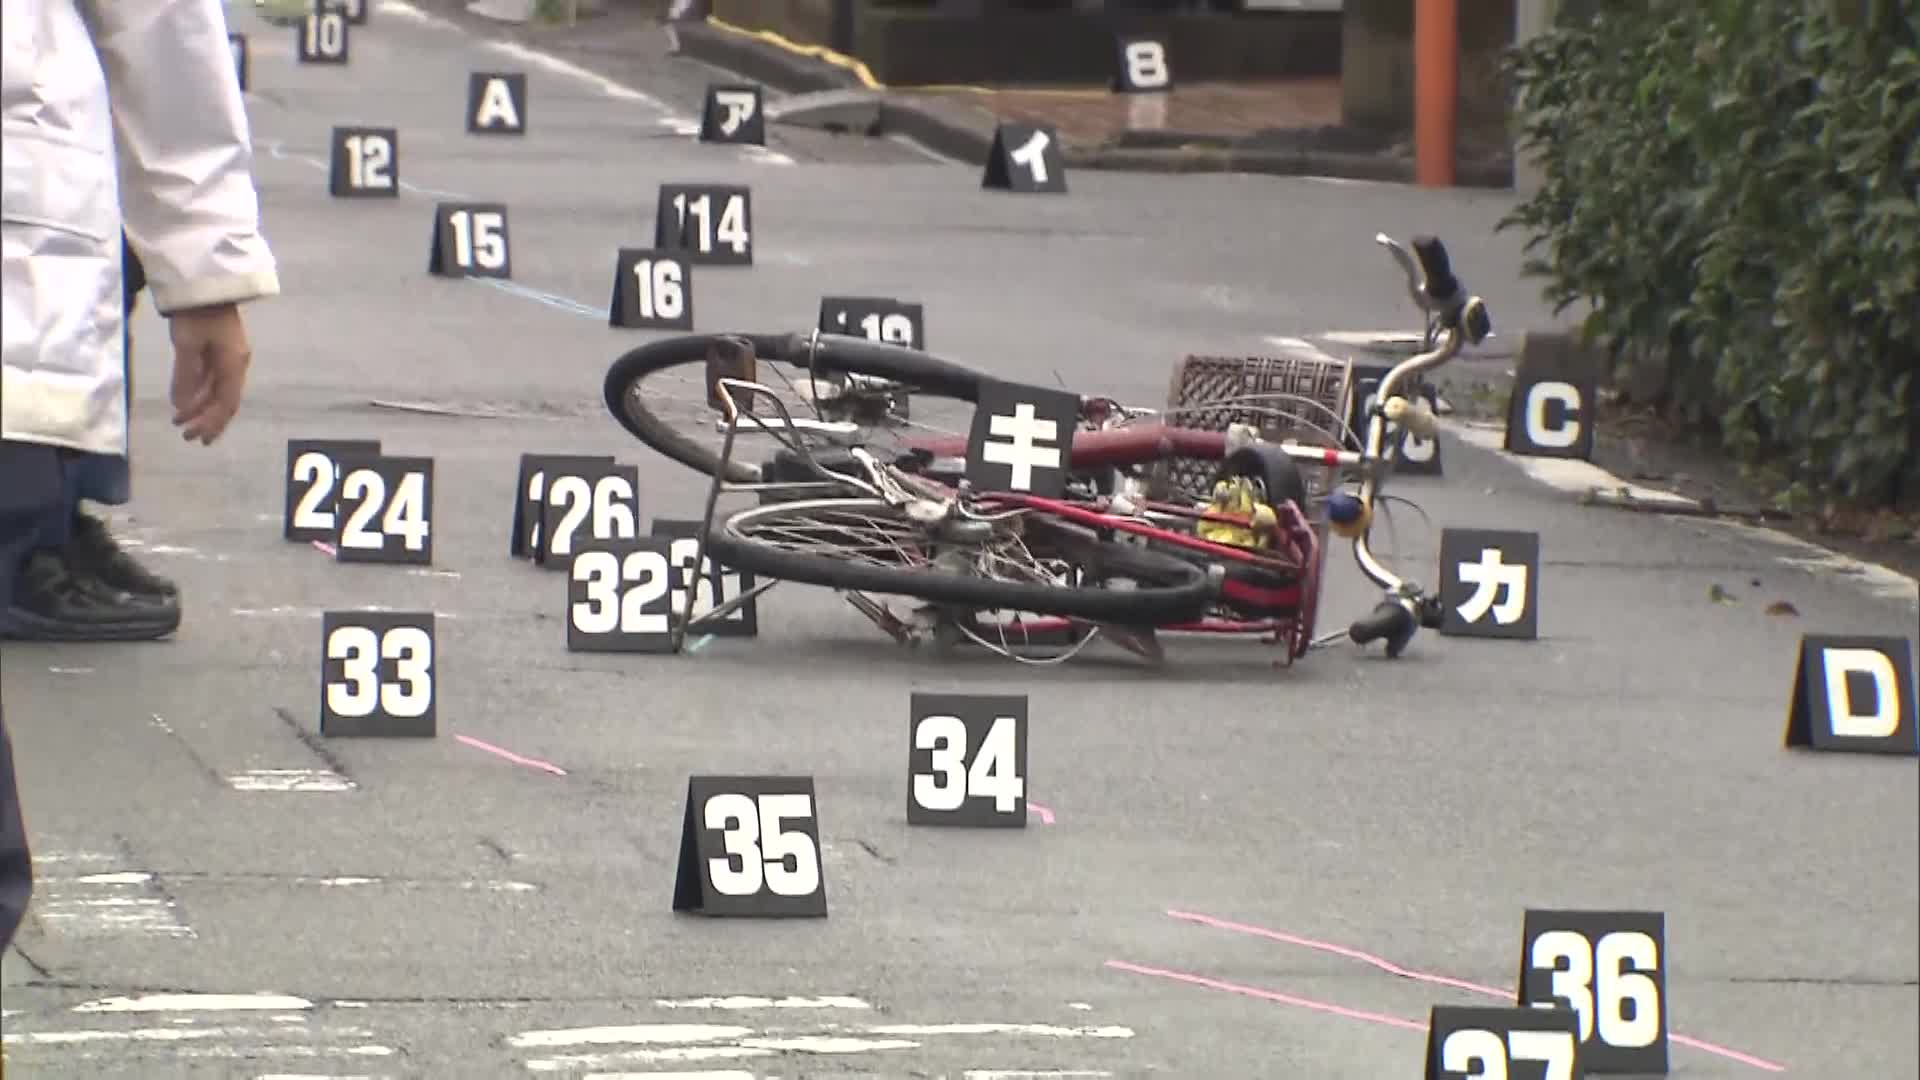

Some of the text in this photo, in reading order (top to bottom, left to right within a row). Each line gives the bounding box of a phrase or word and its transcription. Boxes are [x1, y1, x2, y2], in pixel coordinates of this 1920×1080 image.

[477, 78, 519, 127] A
[716, 92, 756, 135] ア
[345, 135, 392, 188] 12
[1010, 130, 1050, 183] イ
[449, 210, 505, 269] 15
[688, 194, 749, 254] 14
[633, 259, 684, 320] 16
[982, 403, 1061, 491] キ
[1525, 381, 1580, 447] C
[293, 451, 340, 529] 2
[340, 468, 430, 551] 24
[549, 475, 636, 556] 26
[572, 550, 669, 635] 32
[1456, 548, 1527, 625] カ
[326, 626, 433, 718] 33
[1823, 648, 1901, 738] D
[913, 715, 1024, 813] 34
[704, 793, 820, 896] 35
[1530, 929, 1660, 1048] 36
